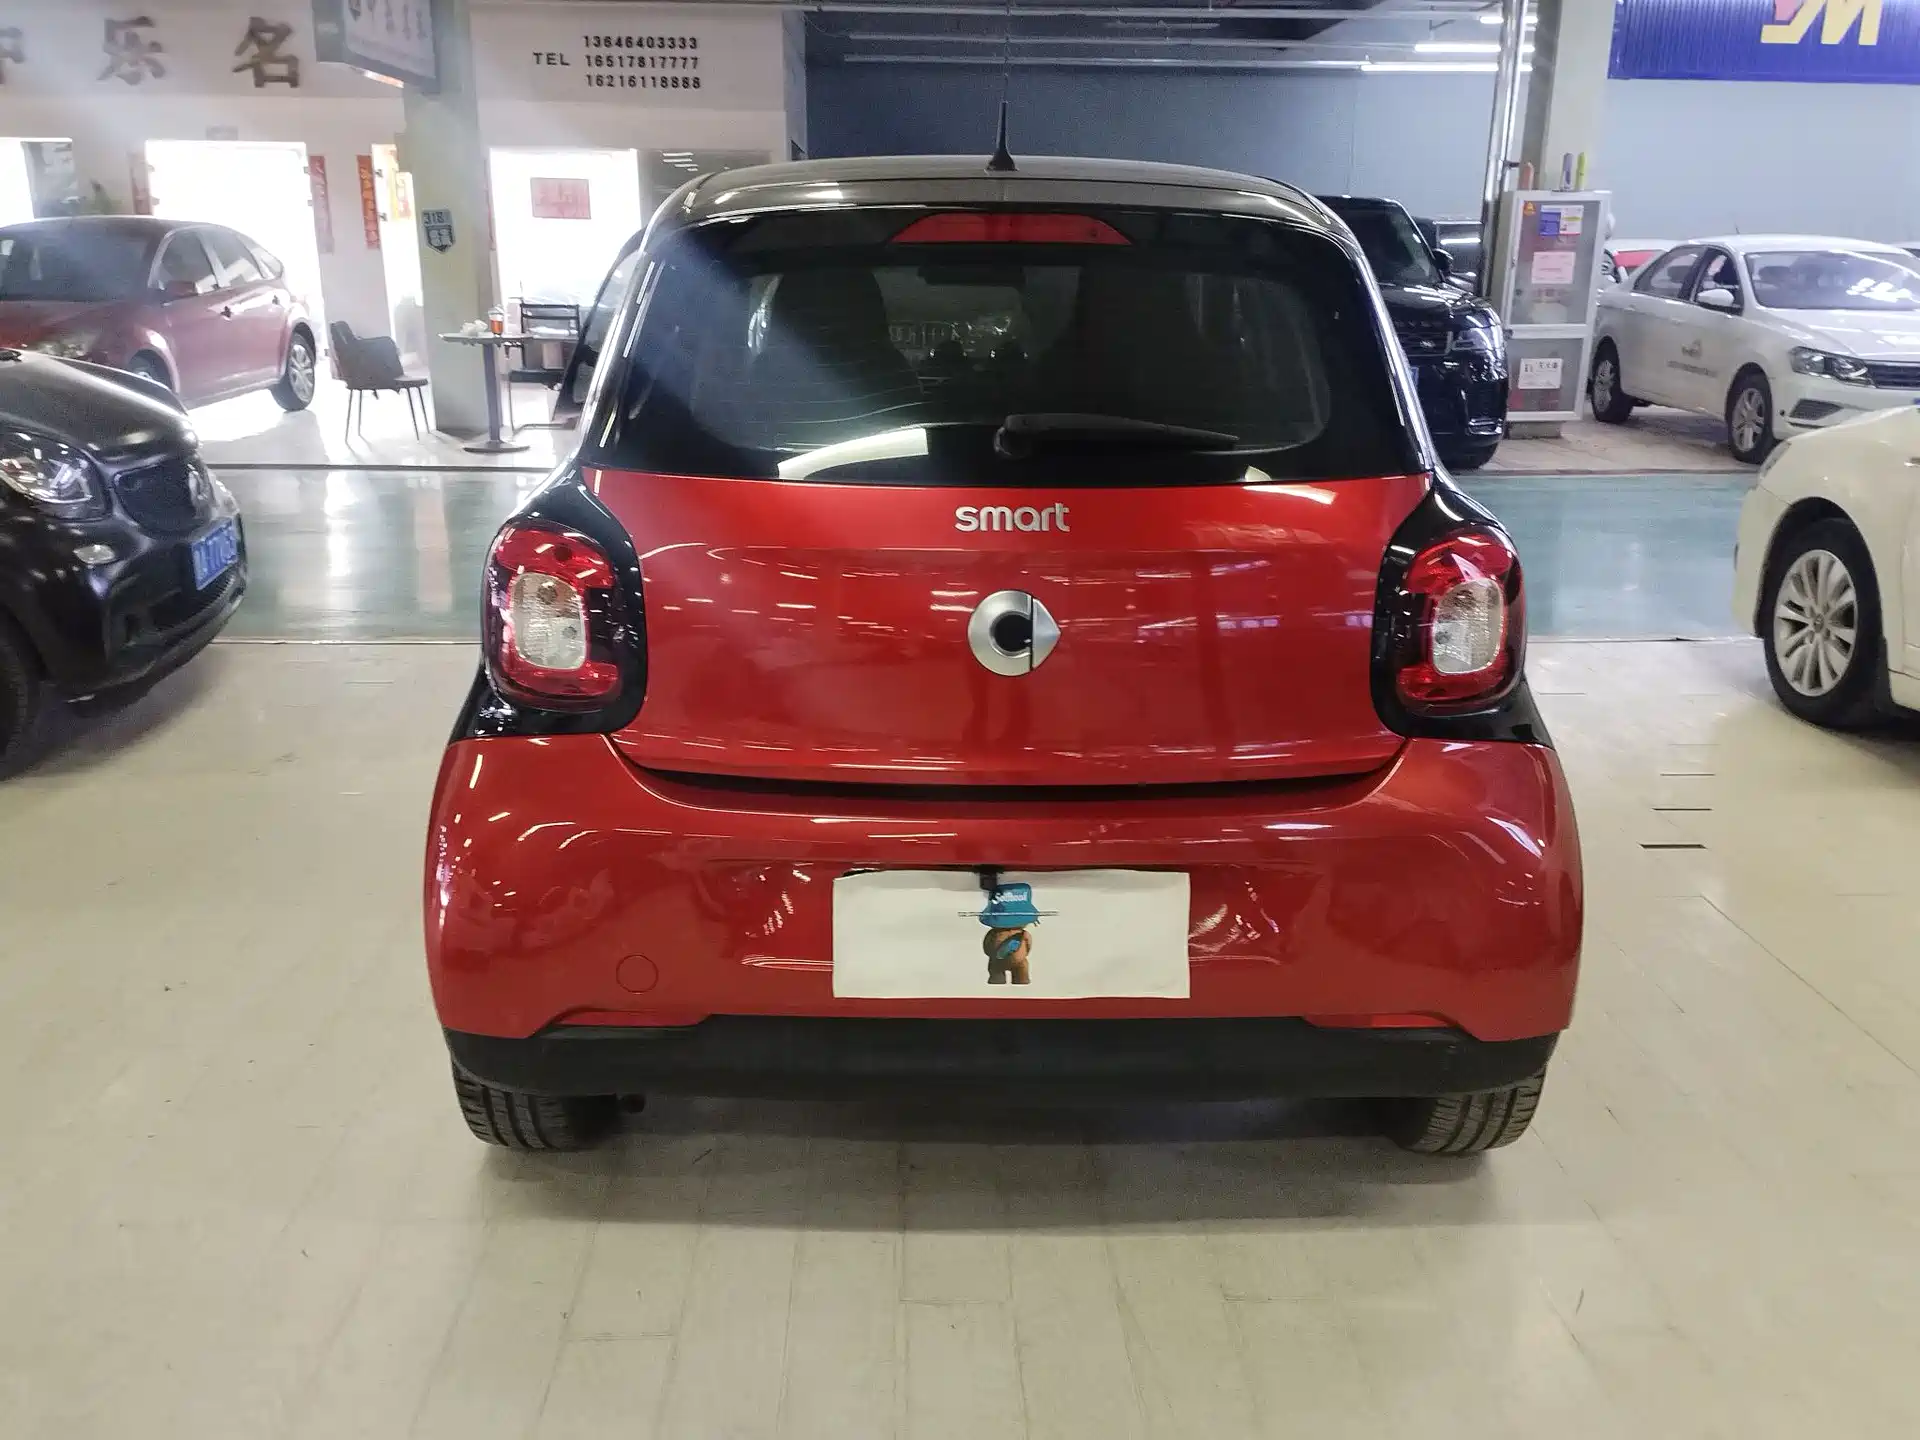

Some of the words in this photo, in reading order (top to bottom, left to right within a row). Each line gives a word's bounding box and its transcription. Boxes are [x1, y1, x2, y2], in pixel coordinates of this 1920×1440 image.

[583, 35, 698, 50] 13646403333
[532, 52, 571, 66] TEL
[584, 55, 699, 70] 16517817777
[585, 74, 701, 89] 16216118888
[954, 502, 1071, 532] smart
